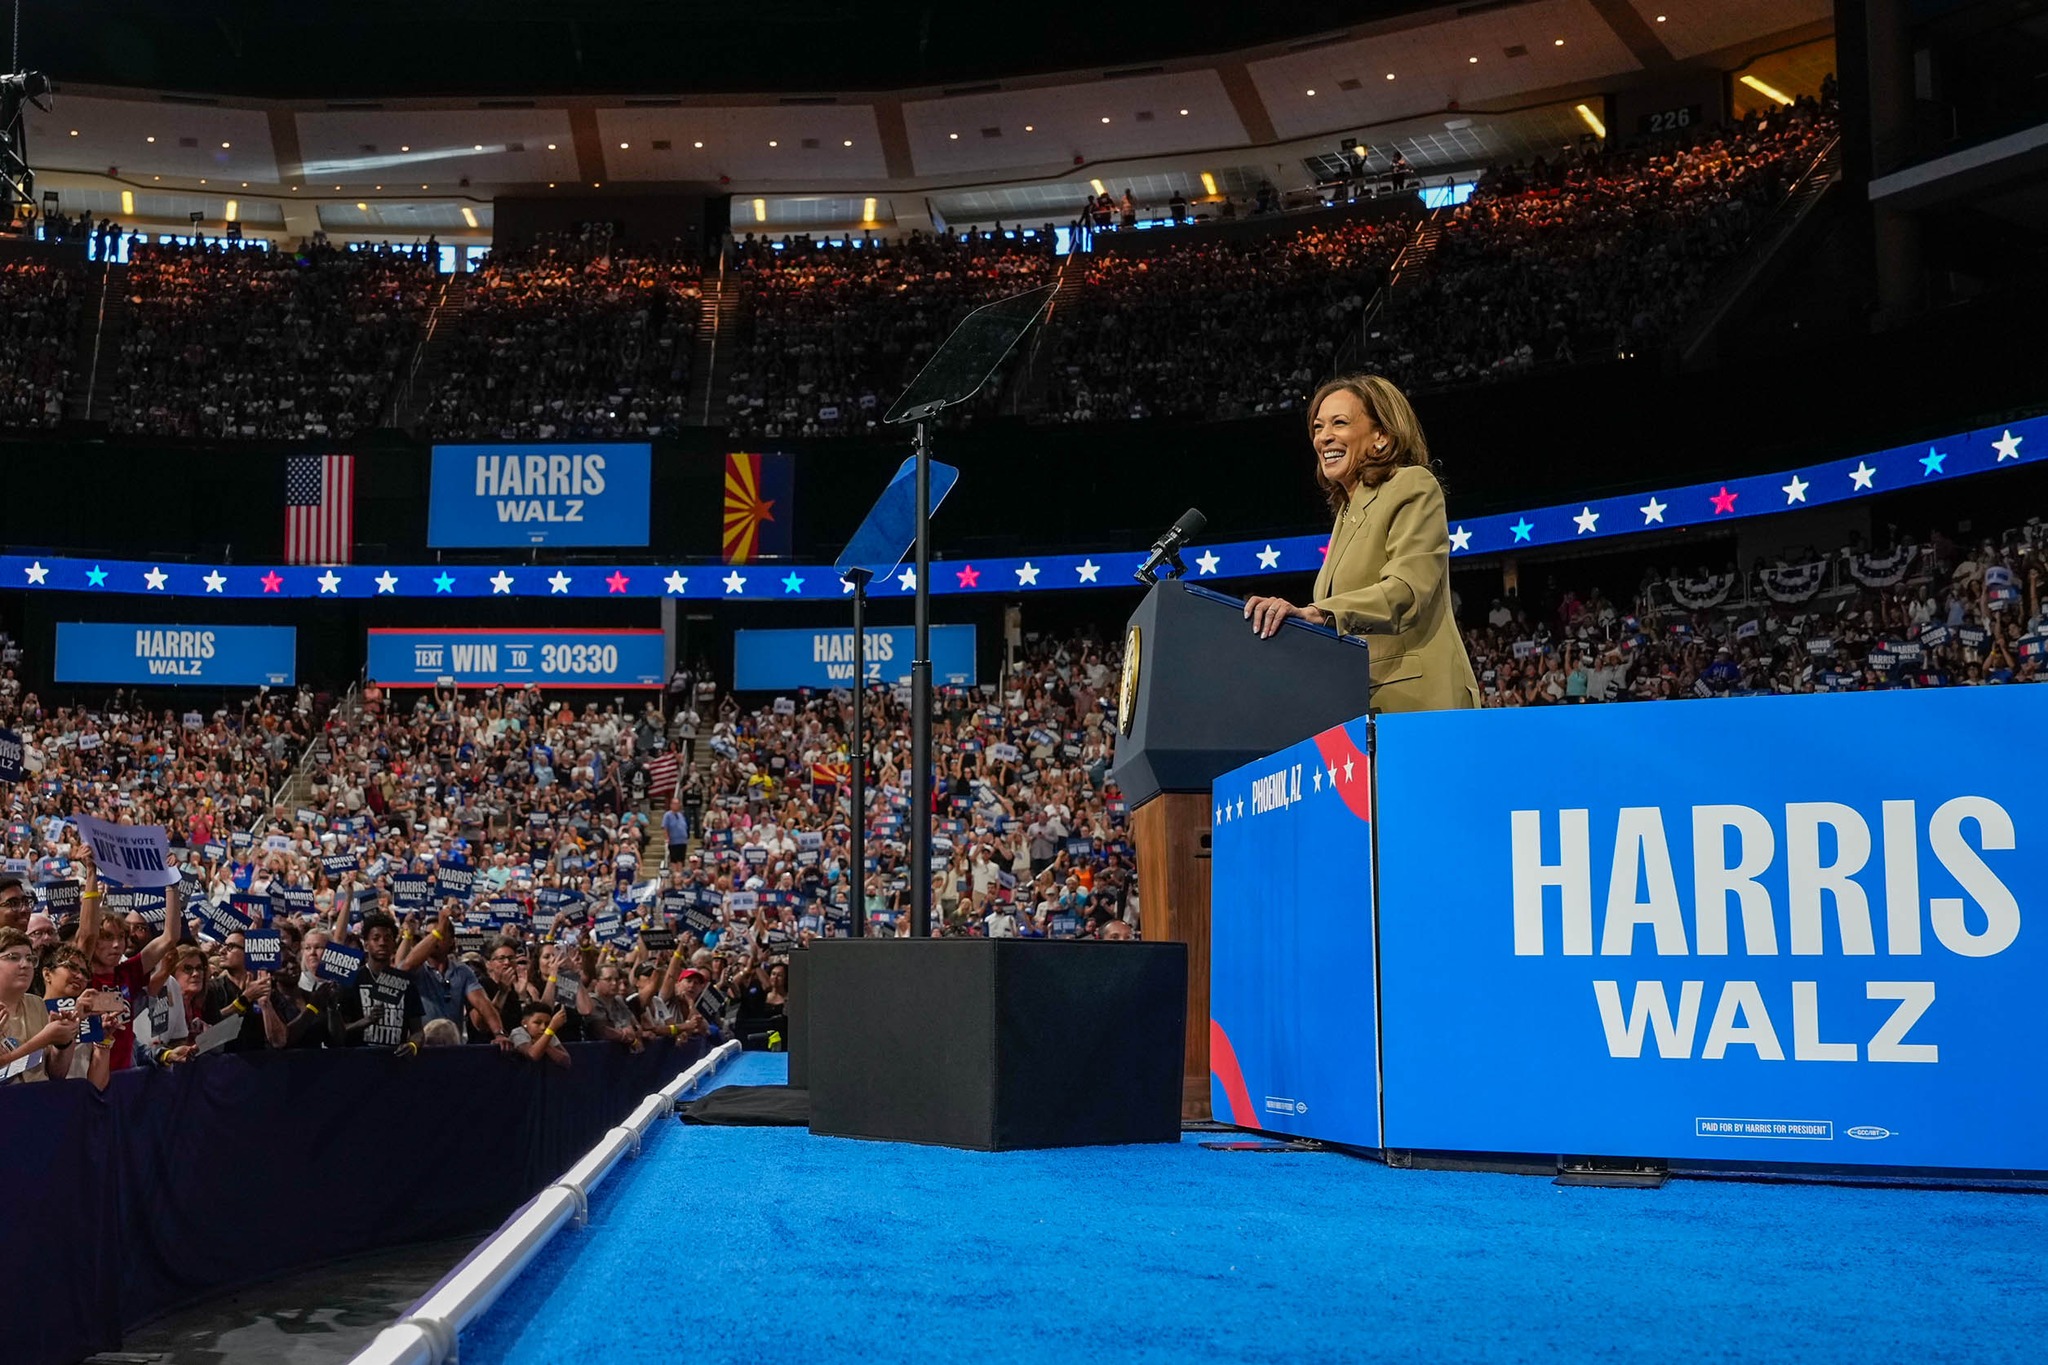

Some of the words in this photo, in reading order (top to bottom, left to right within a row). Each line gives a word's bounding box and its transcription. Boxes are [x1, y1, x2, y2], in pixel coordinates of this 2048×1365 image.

[1651, 108, 1690, 132] 226
[476, 454, 606, 496] HARRIS
[496, 500, 584, 522] WALZ
[136, 630, 215, 658] HARRIS
[149, 659, 202, 675] WALZ
[415, 651, 443, 667] TEXT
[452, 644, 497, 672] WIN
[511, 651, 527, 667] TO
[541, 644, 618, 674] 30330
[1252, 769, 1291, 816] PHOENIX,
[1290, 763, 1302, 803] AZ
[130, 837, 155, 846] VOTE
[92, 837, 121, 867] WE
[120, 846, 164, 871] WIN
[438, 867, 473, 885] HARRIS
[1510, 796, 2021, 957] HARRIS
[47, 886, 79, 901] HARRIS
[394, 881, 427, 893] HARRIS
[442, 881, 466, 892] WALZ
[52, 898, 75, 907] WALZ
[284, 891, 314, 901] HARRIS
[245, 938, 280, 953] HARRIS
[250, 953, 275, 961] WALZ
[322, 948, 360, 971] HARRIS
[324, 963, 351, 978] WALZ
[376, 972, 410, 991] HARRIS
[1592, 980, 1939, 1063] WALZ
[1702, 1122, 1718, 1132] PAID
[1719, 1123, 1733, 1132] FOR
[1734, 1123, 1744, 1133] BY
[1745, 1123, 1772, 1134] HARRIS
[1773, 1124, 1787, 1134] FOR
[1788, 1125, 1827, 1135] PRESIDENT
